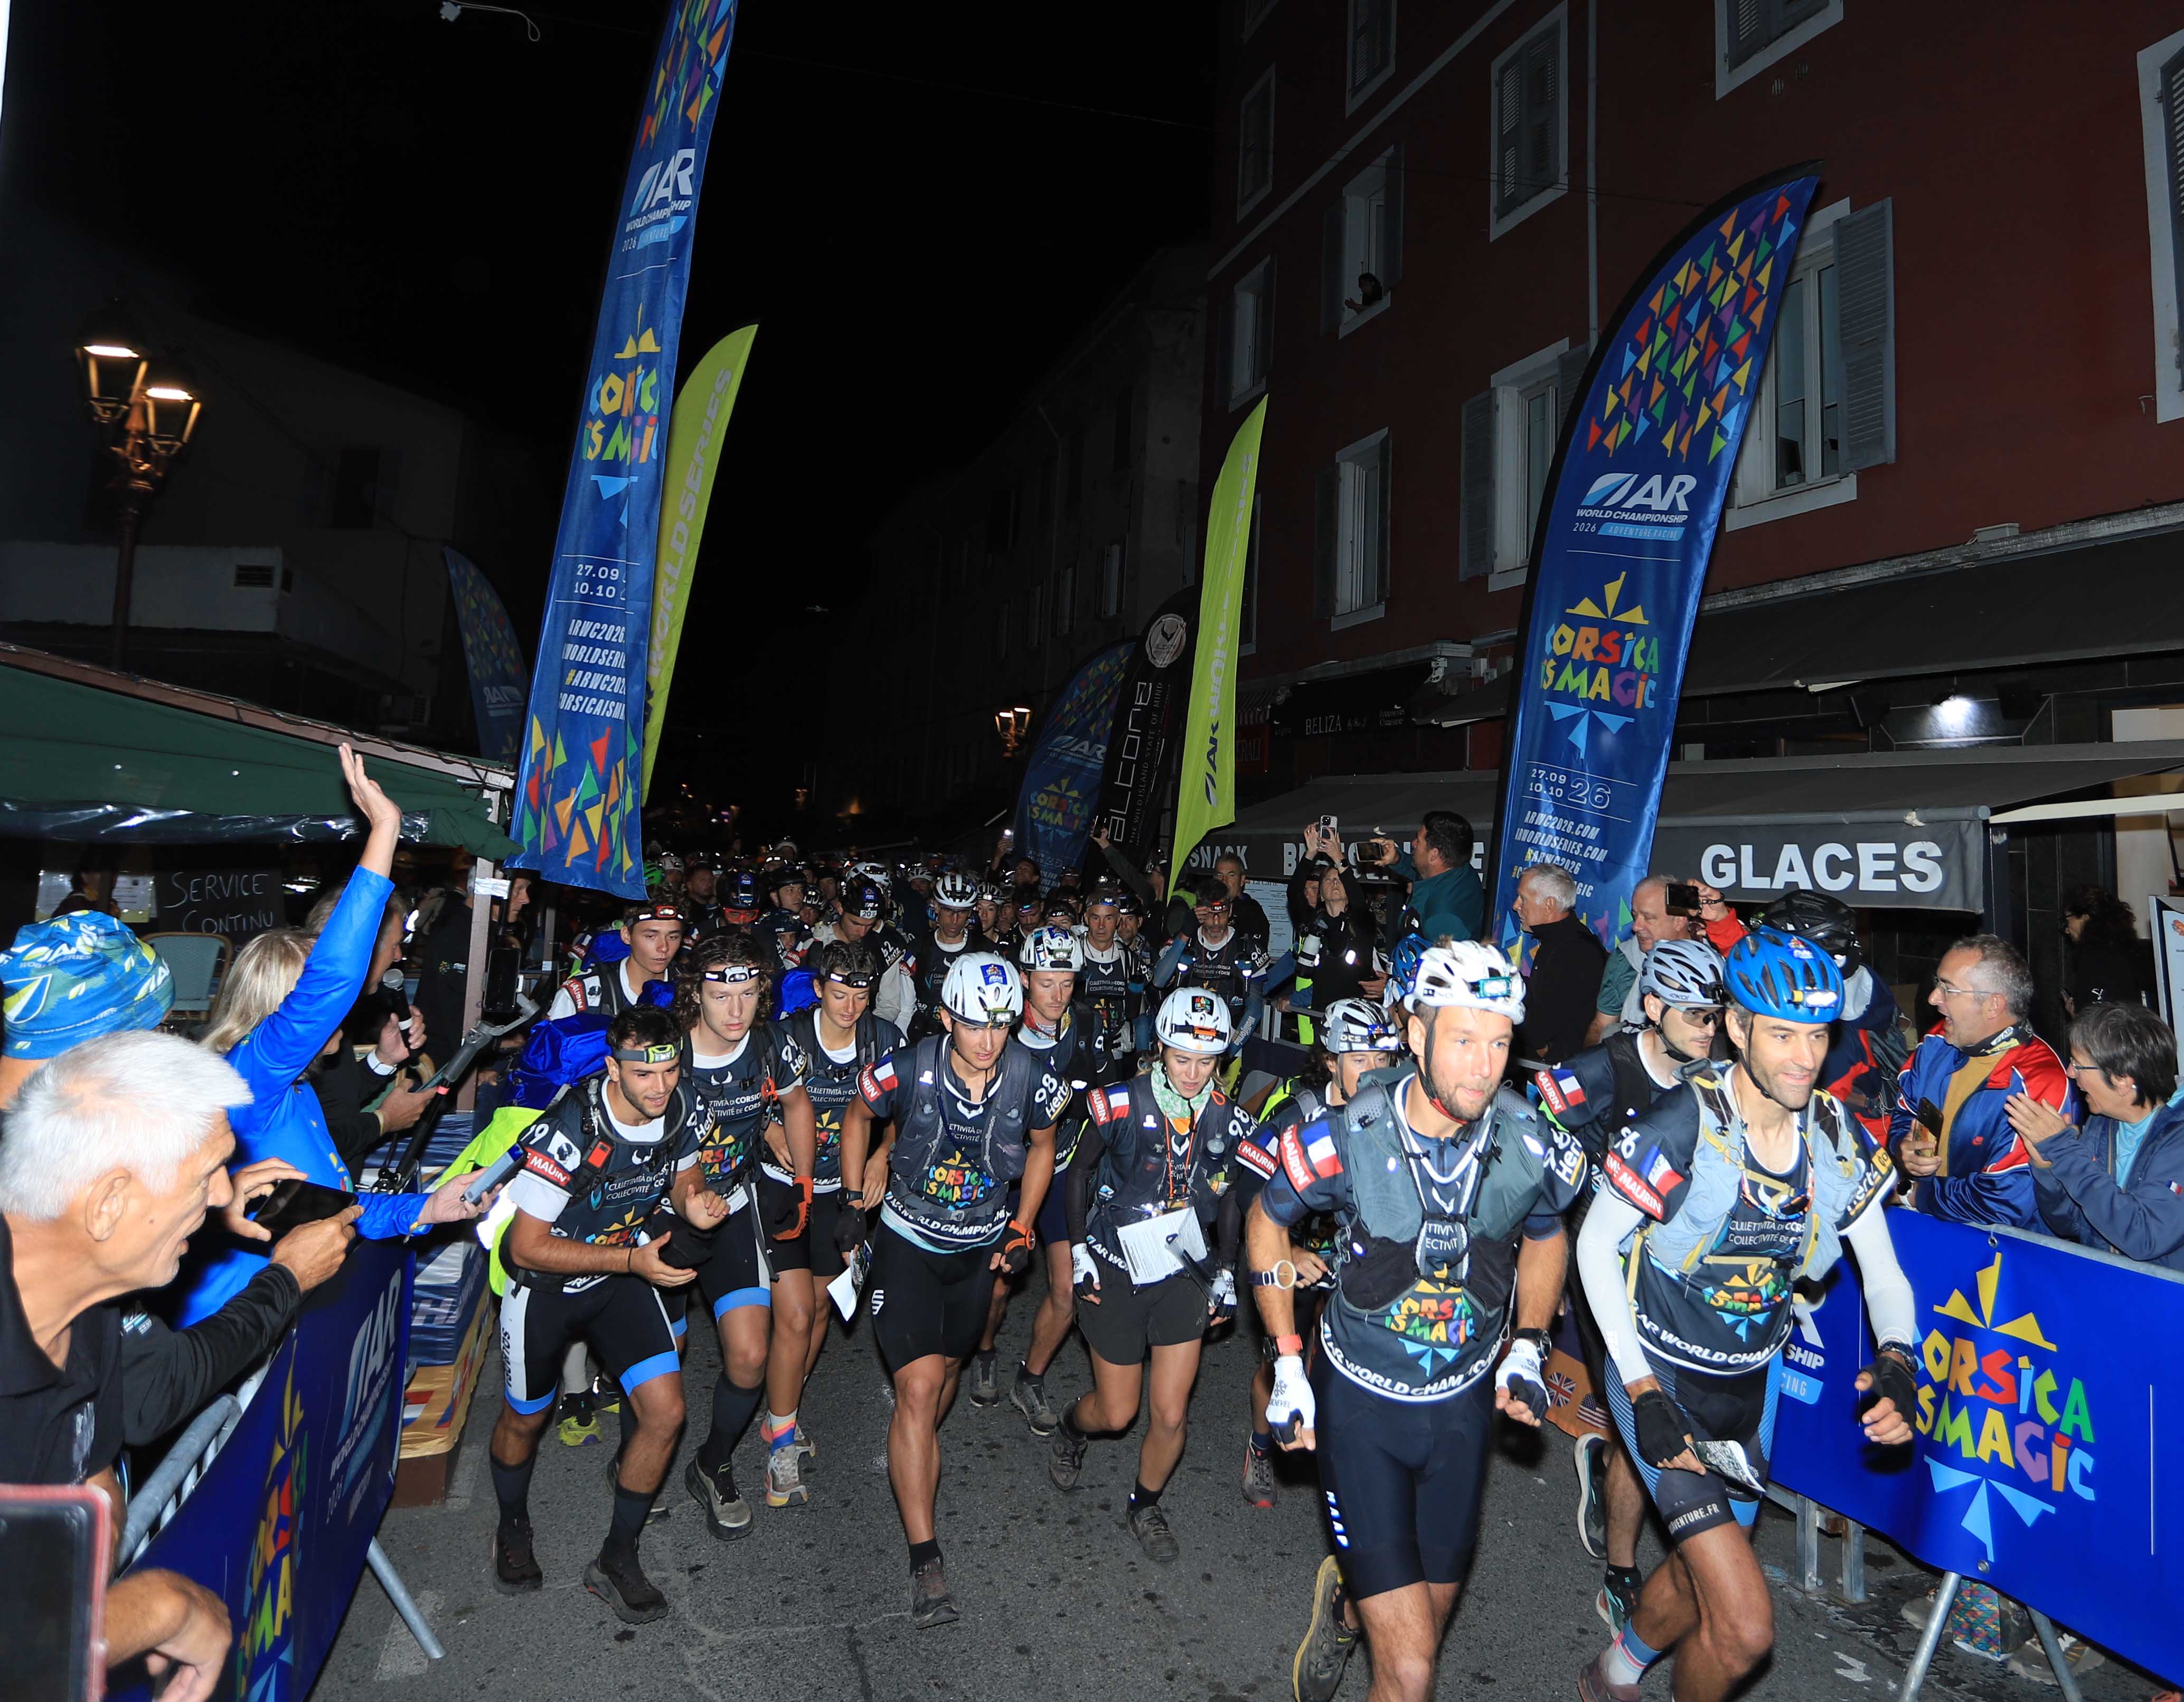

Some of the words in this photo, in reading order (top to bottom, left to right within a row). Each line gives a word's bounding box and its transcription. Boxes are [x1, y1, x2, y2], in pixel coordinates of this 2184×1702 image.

[1621, 474, 1697, 511] AR
[1573, 523, 1597, 532] 2026
[1608, 525, 1650, 537] ADVENTURE
[1653, 529, 1678, 539] RACING
[1576, 509, 1611, 518] WORLD
[1613, 510, 1688, 523] CHAMPIONSHIP
[576, 564, 619, 581] 27.09
[574, 582, 616, 598] 10.10
[1545, 623, 1659, 674] CORSICA
[1153, 682, 1163, 707] MIND
[1553, 660, 1656, 708] MAGIC
[1151, 712, 1158, 724] OF
[1305, 714, 1343, 735] BELIZA
[1145, 730, 1155, 758] STATE
[1138, 762, 1150, 797] ISLAND
[1529, 782, 1563, 797] 10.10
[1531, 768, 1567, 784] 27.09
[1567, 778, 1611, 809] 26
[1524, 810, 1600, 840] ARWC2026.COM
[1514, 827, 1608, 862] ARWORLDSERIES.COM
[1701, 841, 1943, 892] GLACES
[1034, 1073, 1058, 1103] 98
[1045, 1080, 1069, 1118] Hertz
[743, 1101, 761, 1112] CORS
[1228, 1105, 1250, 1137] 98
[1242, 1145, 1278, 1174] MAURIN
[1283, 1131, 1309, 1186] MAURIN
[1618, 1171, 1662, 1214] MAURIN
[1091, 1243, 1108, 1259] AR
[1660, 1329, 1728, 1363] WORLD
[1344, 1360, 1411, 1395] WORLD
[1932, 1393, 2096, 1501] MAGIC
